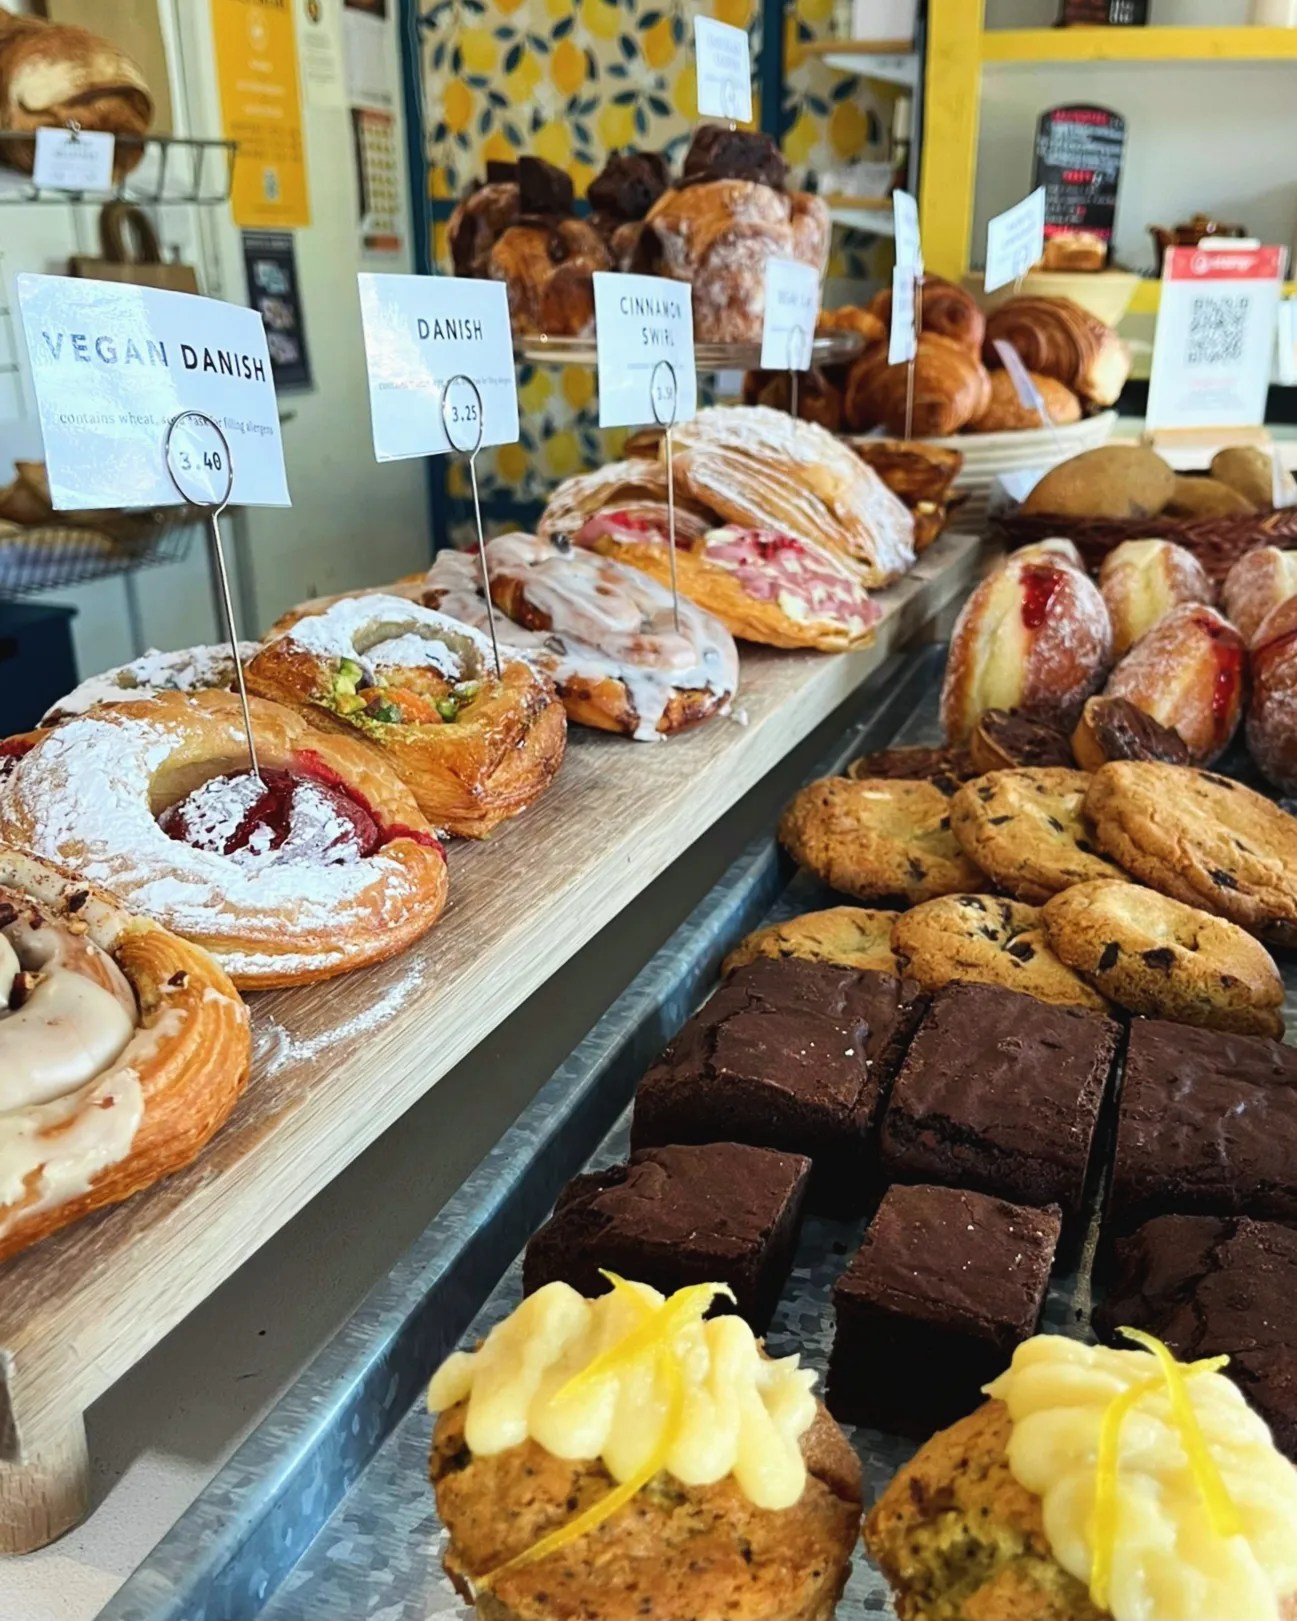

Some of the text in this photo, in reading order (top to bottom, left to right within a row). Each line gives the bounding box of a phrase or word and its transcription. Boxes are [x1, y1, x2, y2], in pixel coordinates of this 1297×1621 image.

[620, 296, 682, 319] CINNAMON
[417, 318, 483, 340] DANISH
[641, 327, 675, 347] SWIRL
[42, 330, 266, 382] VEGAN DANISH
[59, 411, 115, 425] contains
[452, 405, 477, 423] 3.25
[179, 452, 222, 471] 3.40
